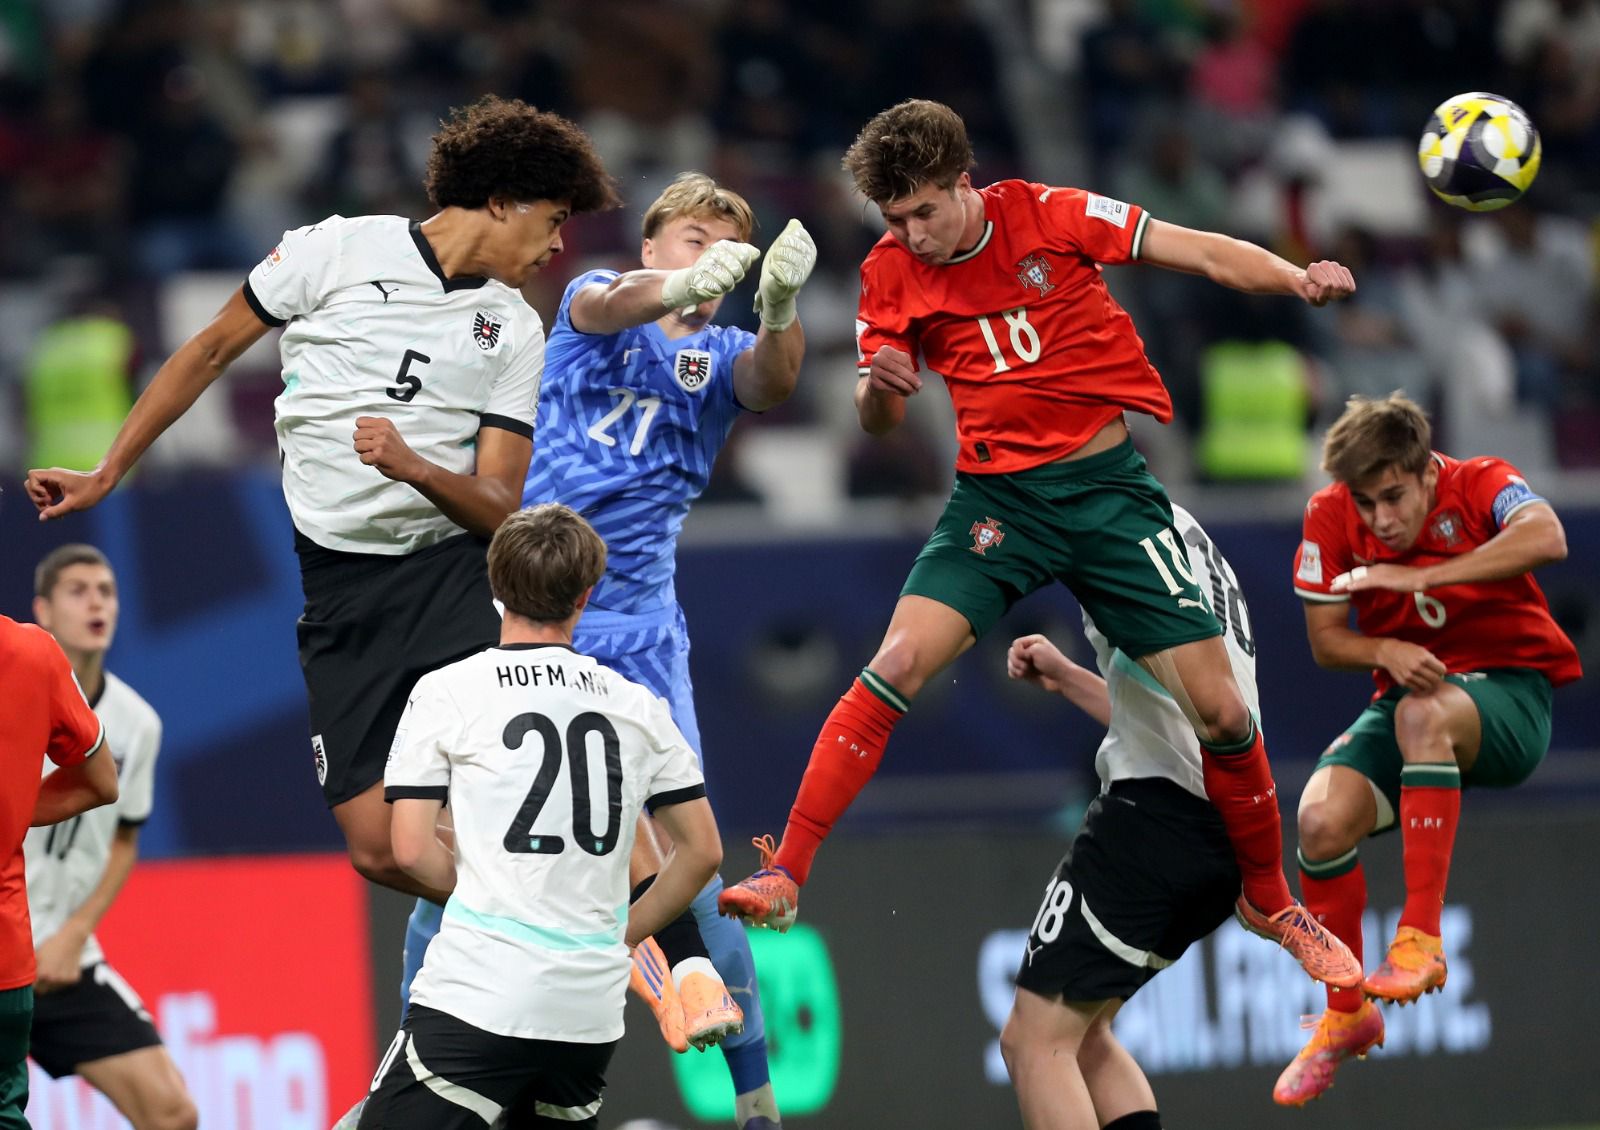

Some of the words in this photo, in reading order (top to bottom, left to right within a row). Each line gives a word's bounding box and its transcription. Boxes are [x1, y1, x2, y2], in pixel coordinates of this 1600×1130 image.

[977, 305, 1041, 374] 18
[386, 349, 430, 403] 5
[587, 386, 661, 456] 21
[1138, 527, 1198, 596] 18
[1183, 525, 1256, 658] 18
[1414, 590, 1448, 629] 6
[497, 664, 609, 699] HOFMANN
[502, 711, 623, 857] 20
[1031, 875, 1073, 944] 18
[370, 1030, 405, 1092] 0
